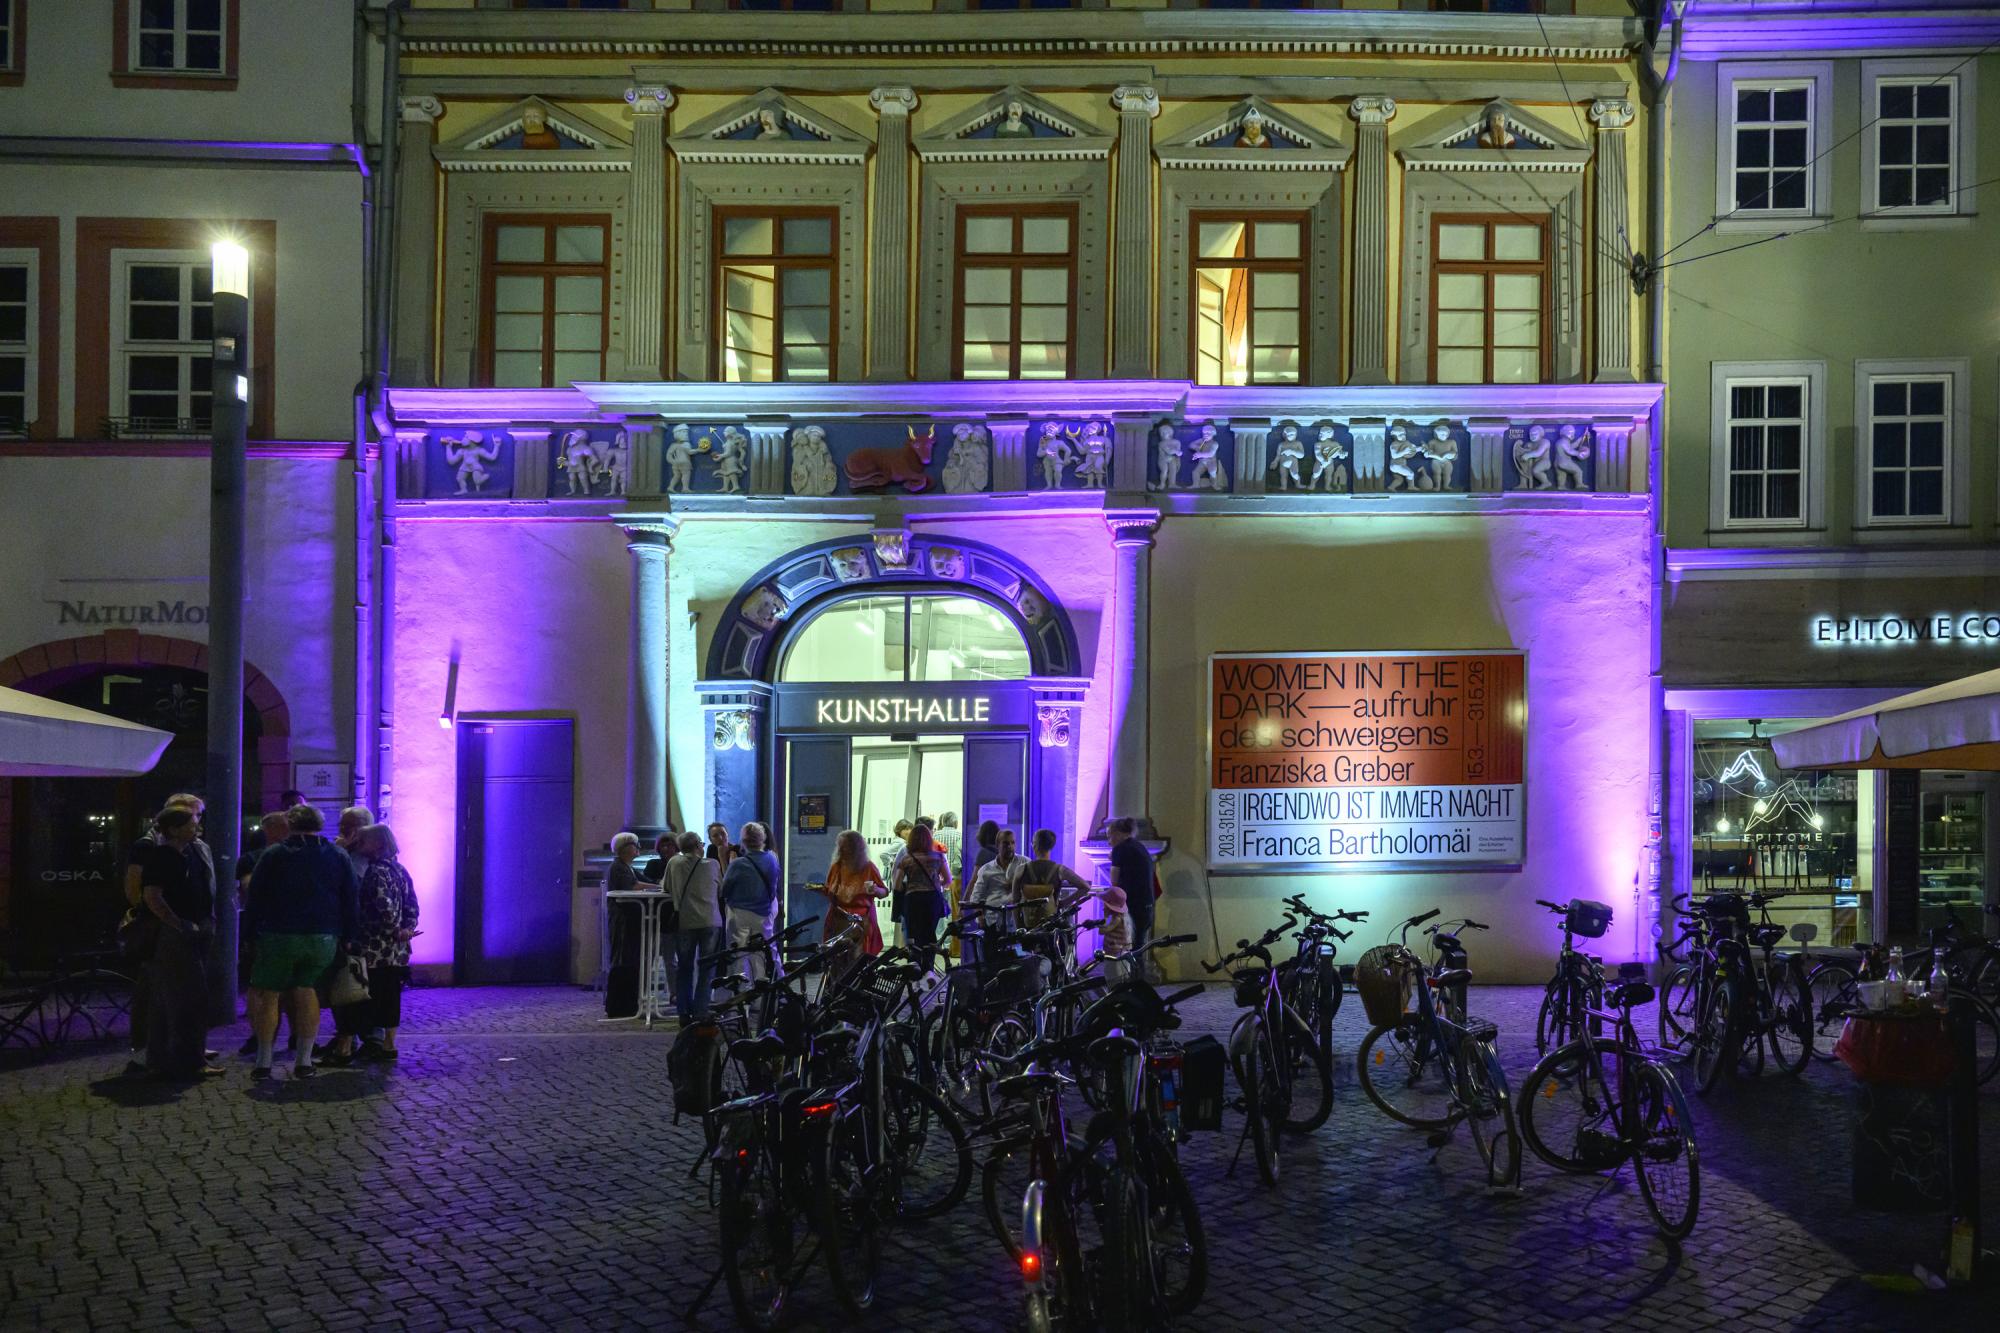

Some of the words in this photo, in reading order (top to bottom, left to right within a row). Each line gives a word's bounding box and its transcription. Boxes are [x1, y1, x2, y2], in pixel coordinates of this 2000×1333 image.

[1818, 617, 1950, 641] EPITOME
[1221, 663, 1345, 691] WOMEN
[1355, 662, 1383, 689] IN
[1392, 661, 1458, 688] THE
[818, 698, 989, 723] KUNSTHALLE
[1220, 721, 1273, 748] des
[1281, 719, 1449, 752] schweigens
[1219, 756, 1328, 784] Franziska
[1334, 755, 1415, 783] Greber
[1243, 792, 1341, 821] IRGENDWO
[1347, 791, 1375, 819] IST
[1380, 790, 1443, 818] IMMER
[1449, 788, 1514, 817] NACHT
[1243, 829, 1322, 857] Franca
[1329, 827, 1471, 855] Bartholomäi
[1743, 832, 1823, 842] EPITOME
